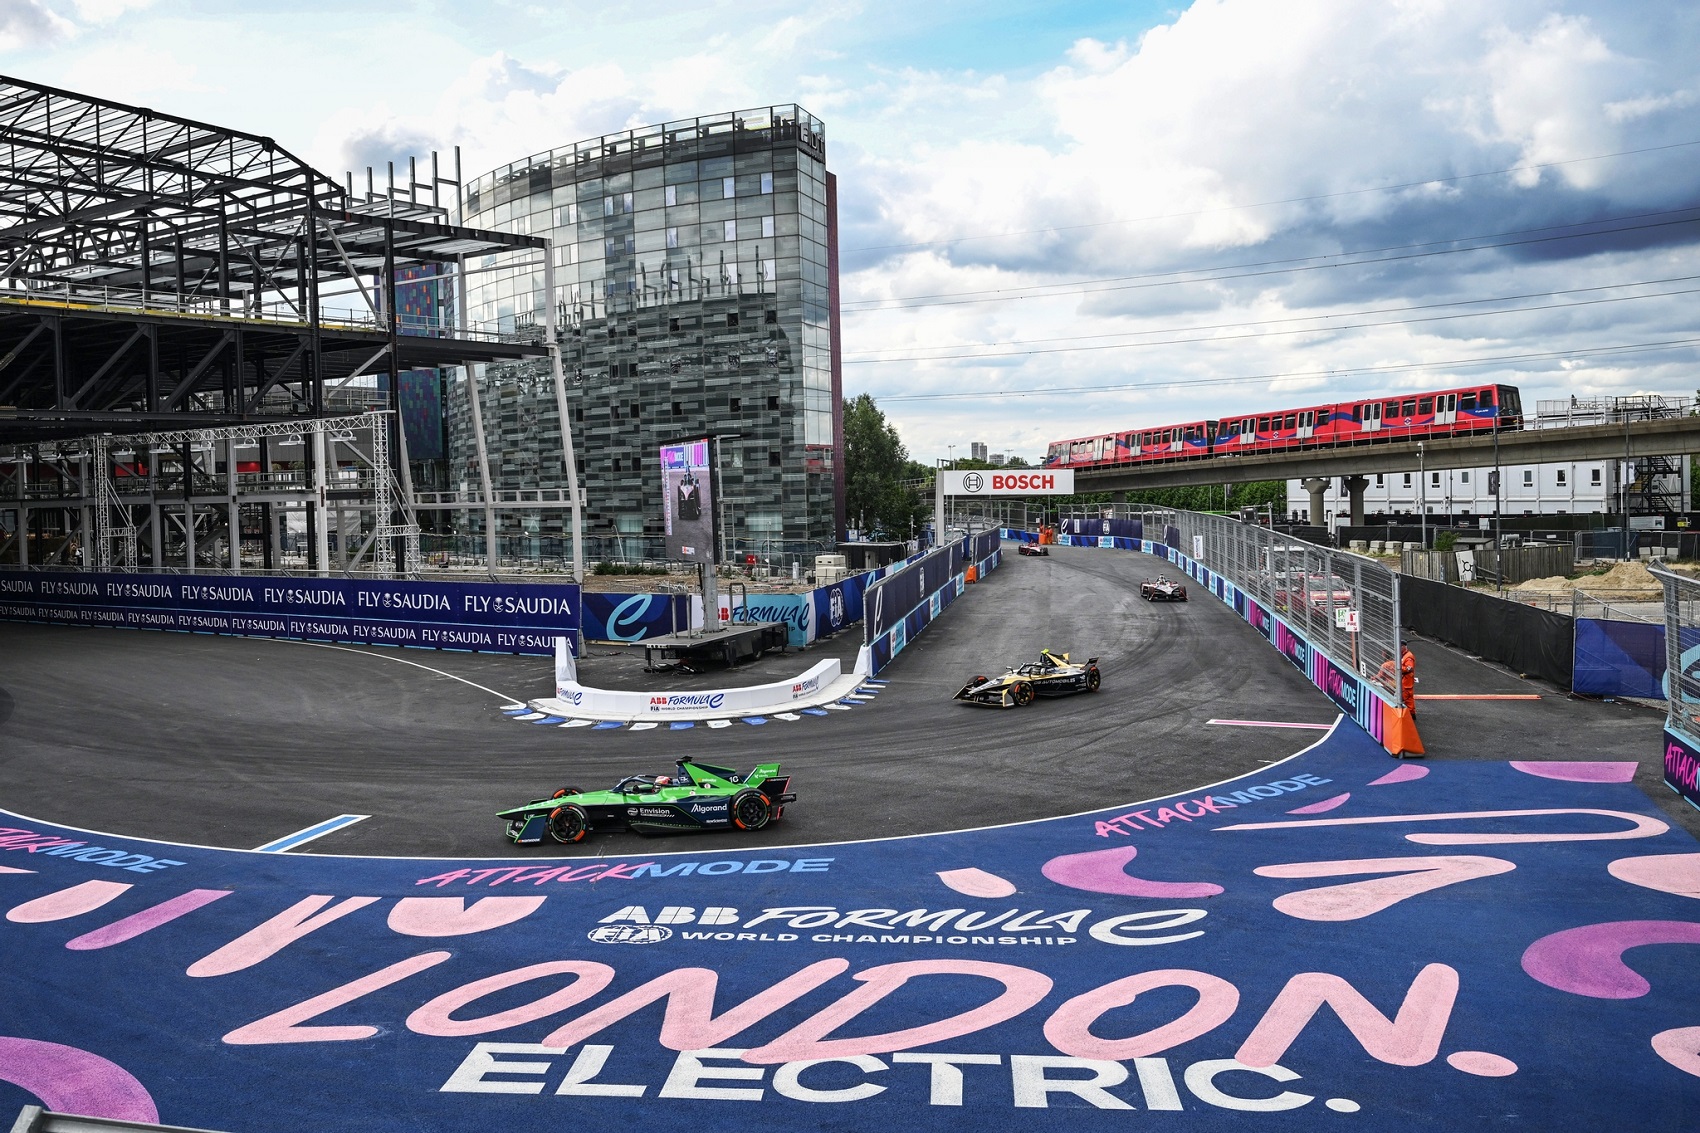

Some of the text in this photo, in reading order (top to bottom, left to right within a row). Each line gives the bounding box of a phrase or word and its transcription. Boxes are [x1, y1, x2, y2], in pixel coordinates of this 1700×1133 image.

[992, 474, 1055, 490] BOSCH
[650, 697, 667, 705] ABB
[668, 695, 711, 706] FORMULA
[691, 804, 728, 814] Algorand
[597, 906, 740, 925] ABB
[744, 907, 1092, 933] FORMULA
[592, 926, 1077, 945] FIA WORLD CHAMPIONSHIP
[222, 951, 1518, 1077] LONDON.
[440, 1042, 1360, 1113] ELECTRIC.
